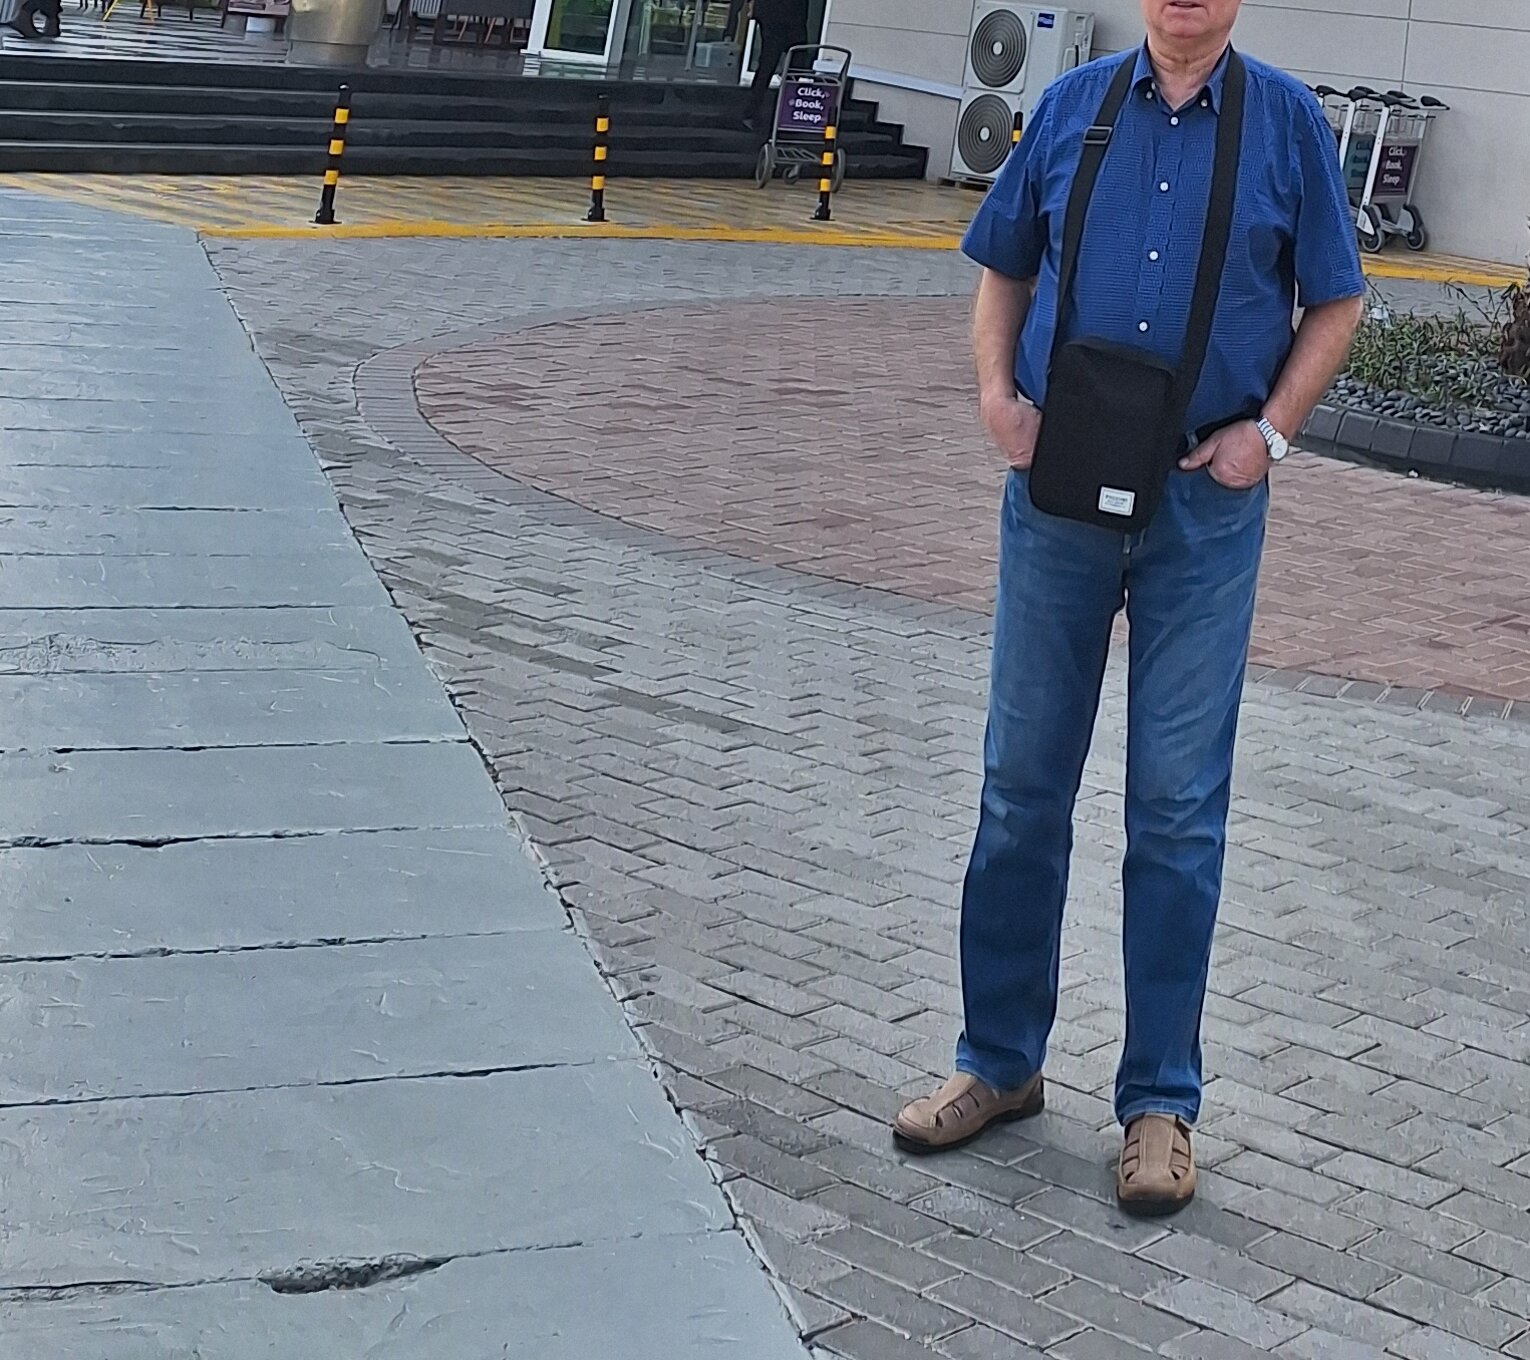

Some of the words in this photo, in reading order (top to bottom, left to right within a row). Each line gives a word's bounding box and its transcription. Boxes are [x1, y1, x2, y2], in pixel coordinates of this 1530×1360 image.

[797, 86, 825, 99] Click,
[795, 98, 824, 111] Book,
[792, 110, 822, 124] Sleep
